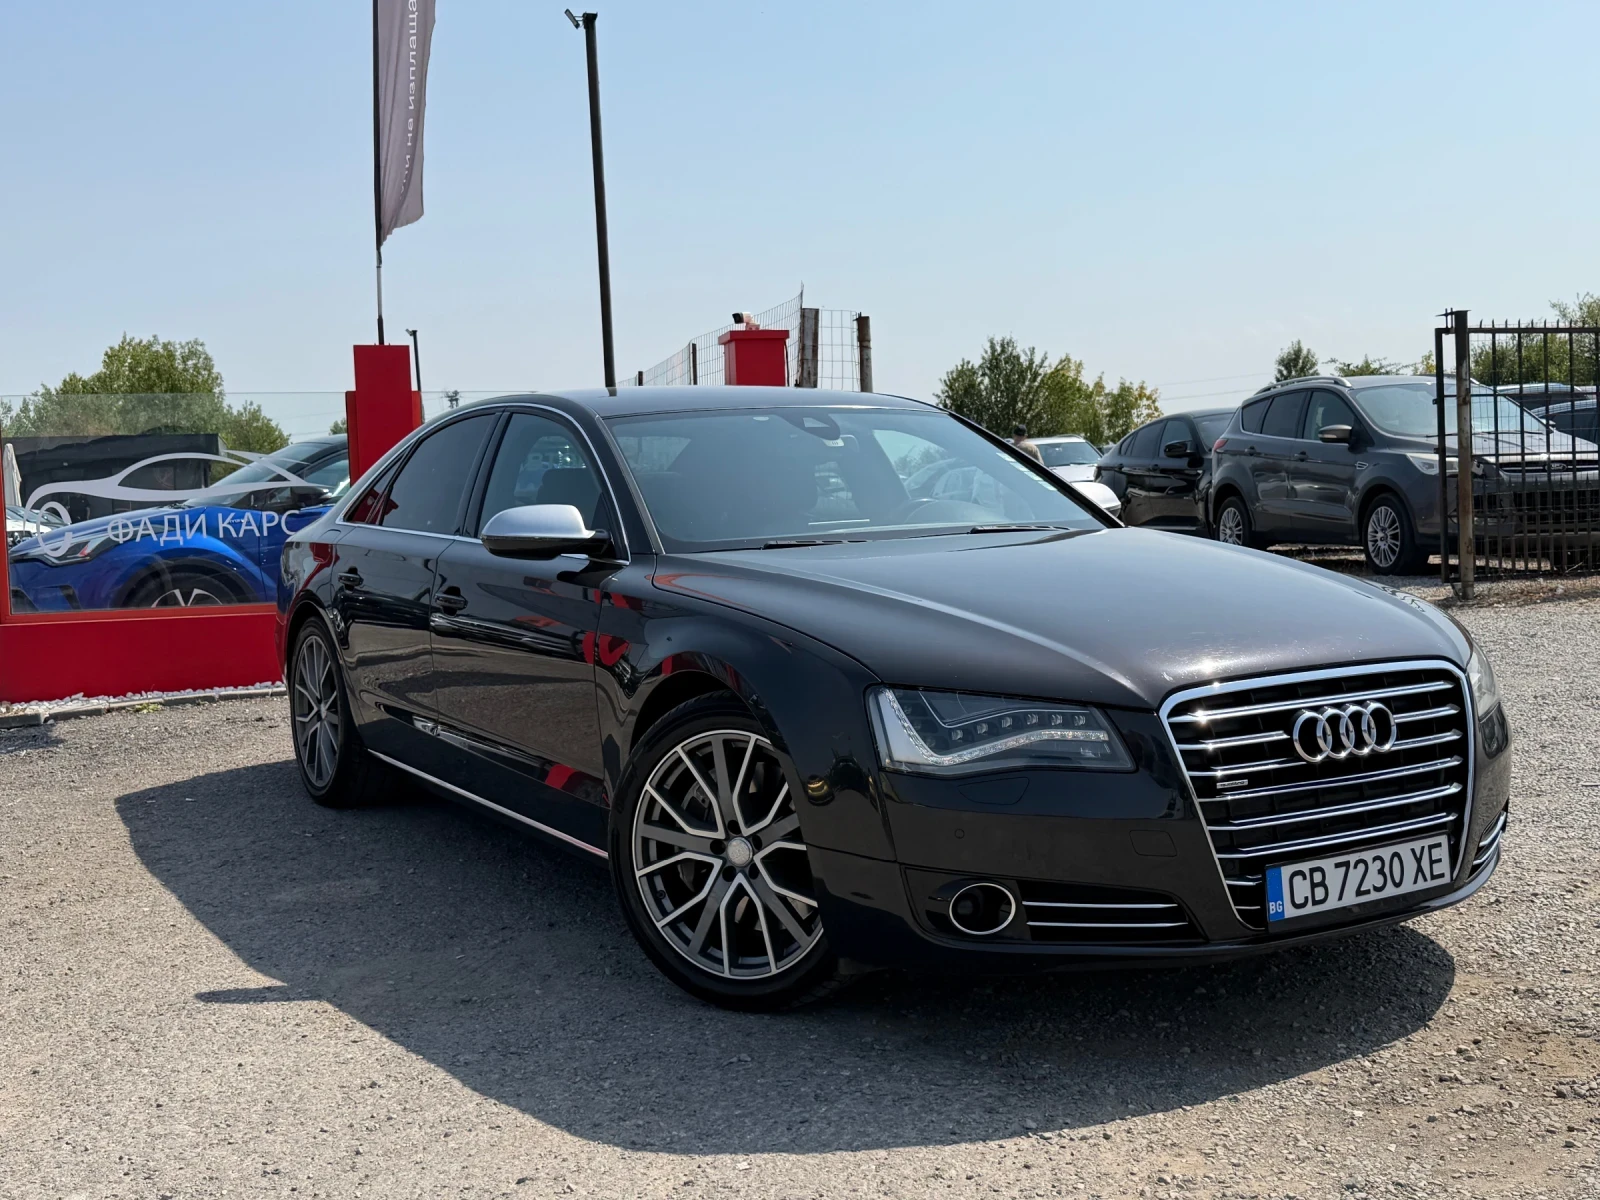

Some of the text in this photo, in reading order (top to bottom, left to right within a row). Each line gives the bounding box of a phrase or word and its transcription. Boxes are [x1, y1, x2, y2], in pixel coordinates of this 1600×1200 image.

[407, 118, 414, 146] на
[107, 509, 300, 547] ФАДИ КАРС
[1288, 842, 1445, 909] CB 7230 XE
[1269, 901, 1283, 914] BG
